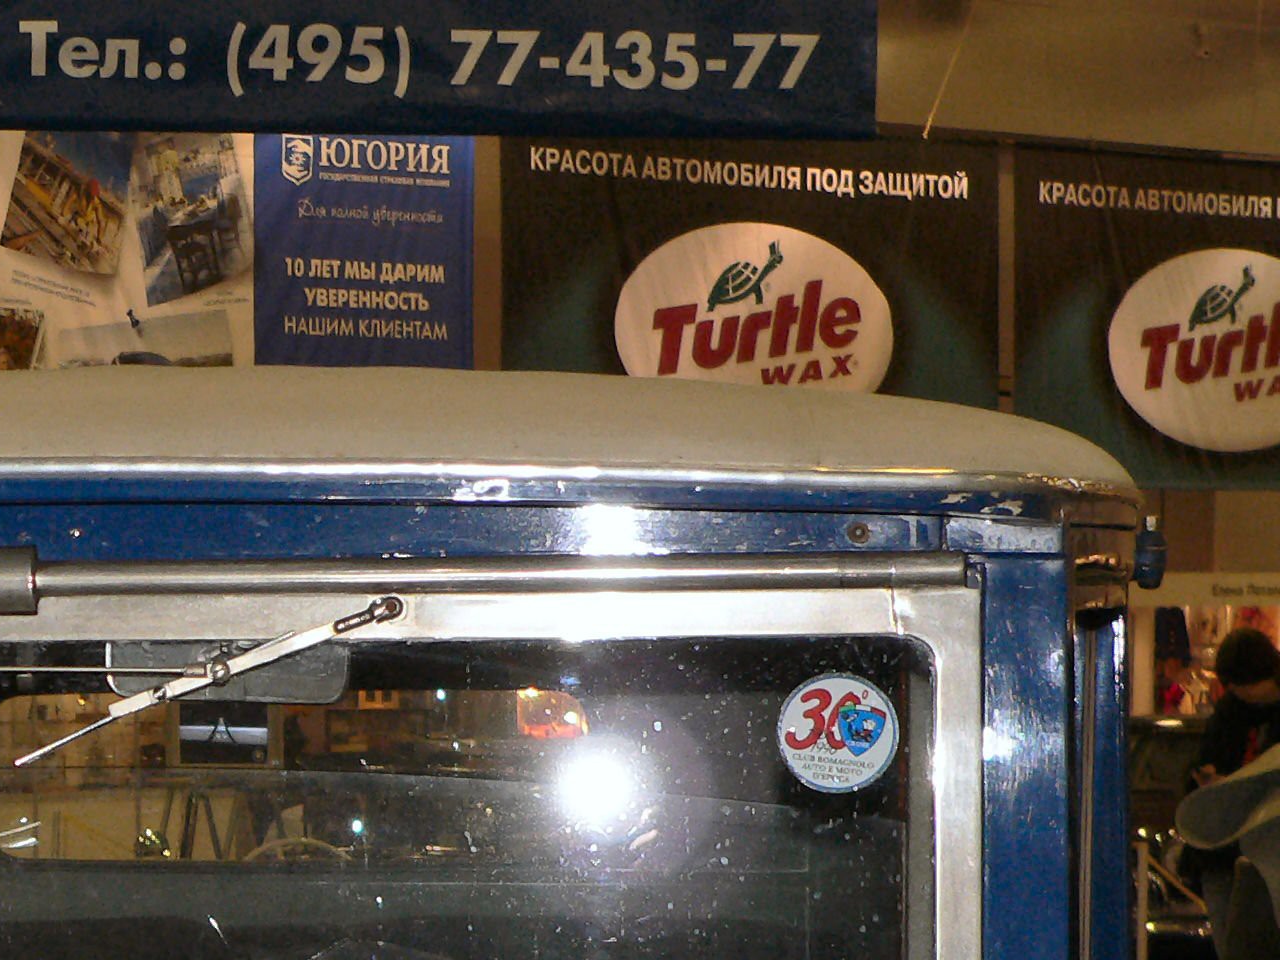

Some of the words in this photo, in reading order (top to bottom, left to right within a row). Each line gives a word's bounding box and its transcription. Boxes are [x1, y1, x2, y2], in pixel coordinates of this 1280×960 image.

[18, 20, 186, 79] Тел.:
[226, 21, 411, 99] (495)
[448, 29, 821, 91] 77-435-77
[318, 136, 451, 175] ЮГОРИЯ
[530, 145, 638, 179] КРАСОТА
[641, 155, 802, 191] АВТОМОБИЛЯ
[806, 167, 855, 199] ПОД
[858, 170, 969, 201] ЗАЩИТОЙ
[1038, 180, 1130, 210] КРАСОТА
[1134, 188, 1273, 220] АВТОМОБИЛЯ
[285, 256, 305, 278] 10
[308, 259, 341, 280] ЛЕТ
[344, 260, 376, 281] МЫ
[379, 262, 446, 285] ДАРИМ
[304, 287, 430, 312] УВЕРЕННОСТЬ
[284, 315, 355, 337] НАШИМ
[358, 317, 449, 341] КЛИЕНТАМ
[652, 279, 862, 376] Turtle
[760, 354, 853, 386] WAX
